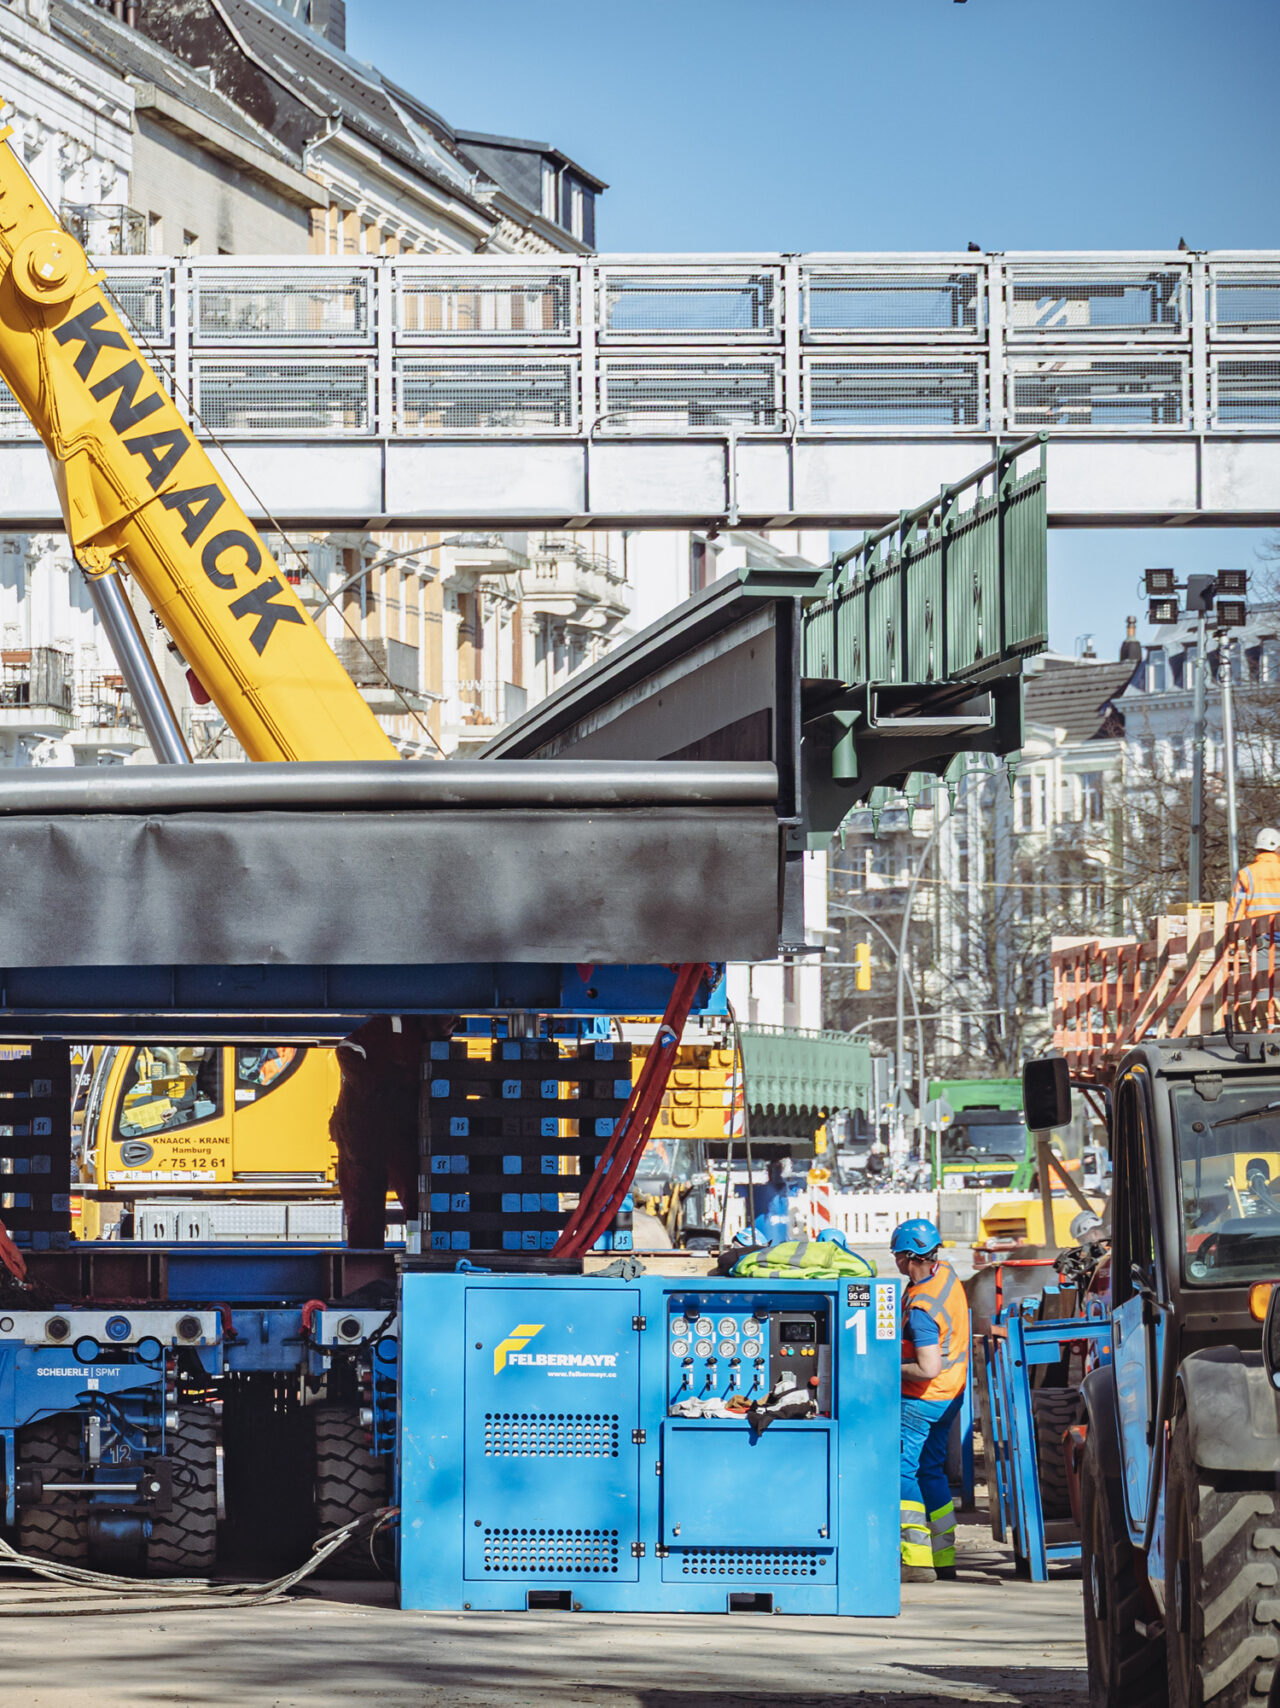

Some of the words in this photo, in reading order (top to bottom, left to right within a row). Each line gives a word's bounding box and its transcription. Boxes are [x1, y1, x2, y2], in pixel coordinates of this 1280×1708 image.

[53, 302, 307, 656] KNAACK
[171, 1158, 186, 1168] 75
[192, 1158, 206, 1168] 12
[211, 1158, 225, 1168] 61
[848, 1292, 858, 1300] 95
[859, 1292, 870, 1300] dB
[845, 1309, 867, 1355] 1
[508, 1353, 617, 1367] FELBERMAYR
[37, 1367, 89, 1376] SCHEUERLE
[95, 1367, 121, 1377] SPMT
[110, 1444, 131, 1464] 12
